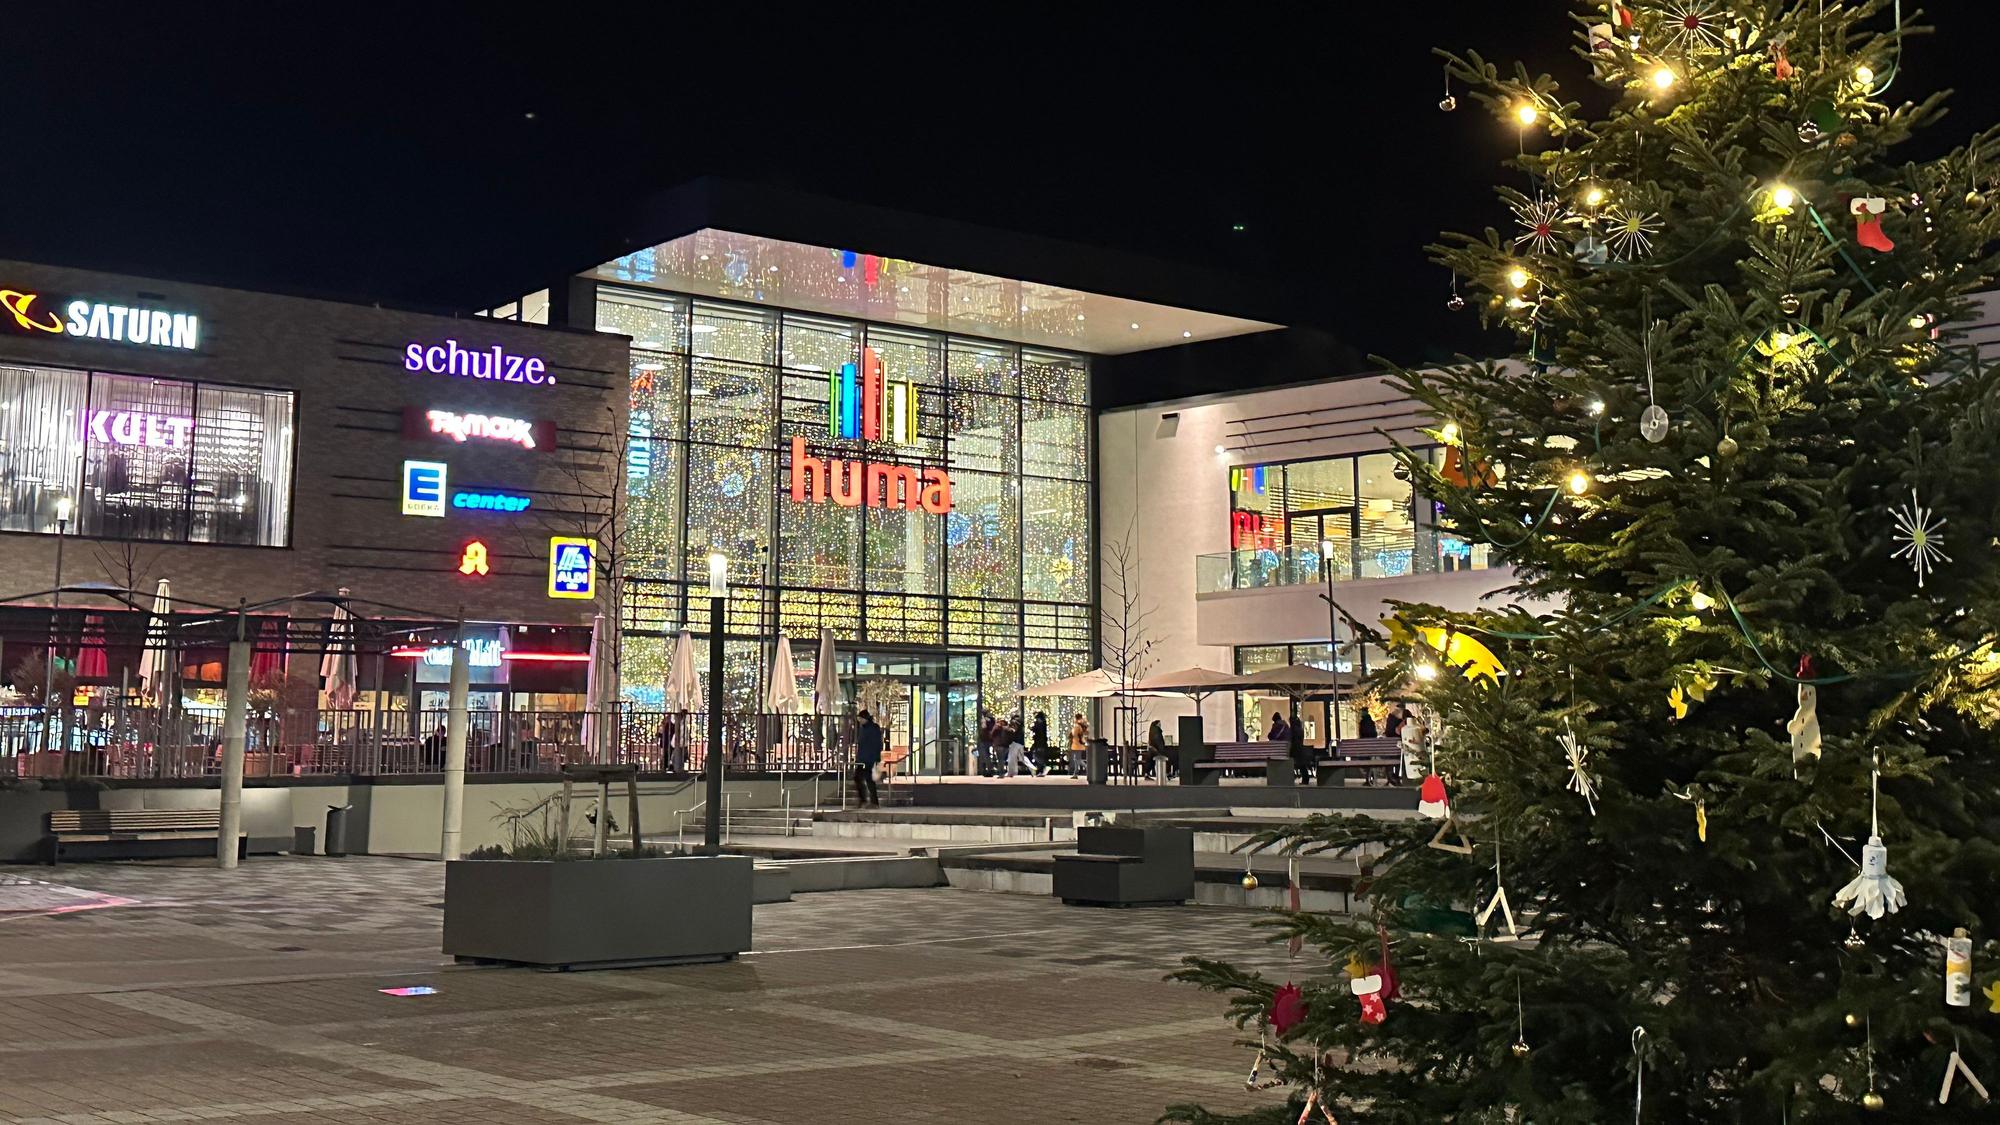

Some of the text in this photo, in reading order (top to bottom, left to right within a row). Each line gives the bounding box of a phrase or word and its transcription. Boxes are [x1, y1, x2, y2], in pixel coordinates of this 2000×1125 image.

[66, 301, 197, 349] SATURN
[405, 340, 556, 385] schulze.
[81, 409, 195, 449] KULT
[792, 436, 951, 514] huma
[453, 493, 530, 512] center
[556, 571, 587, 583] ALDI
